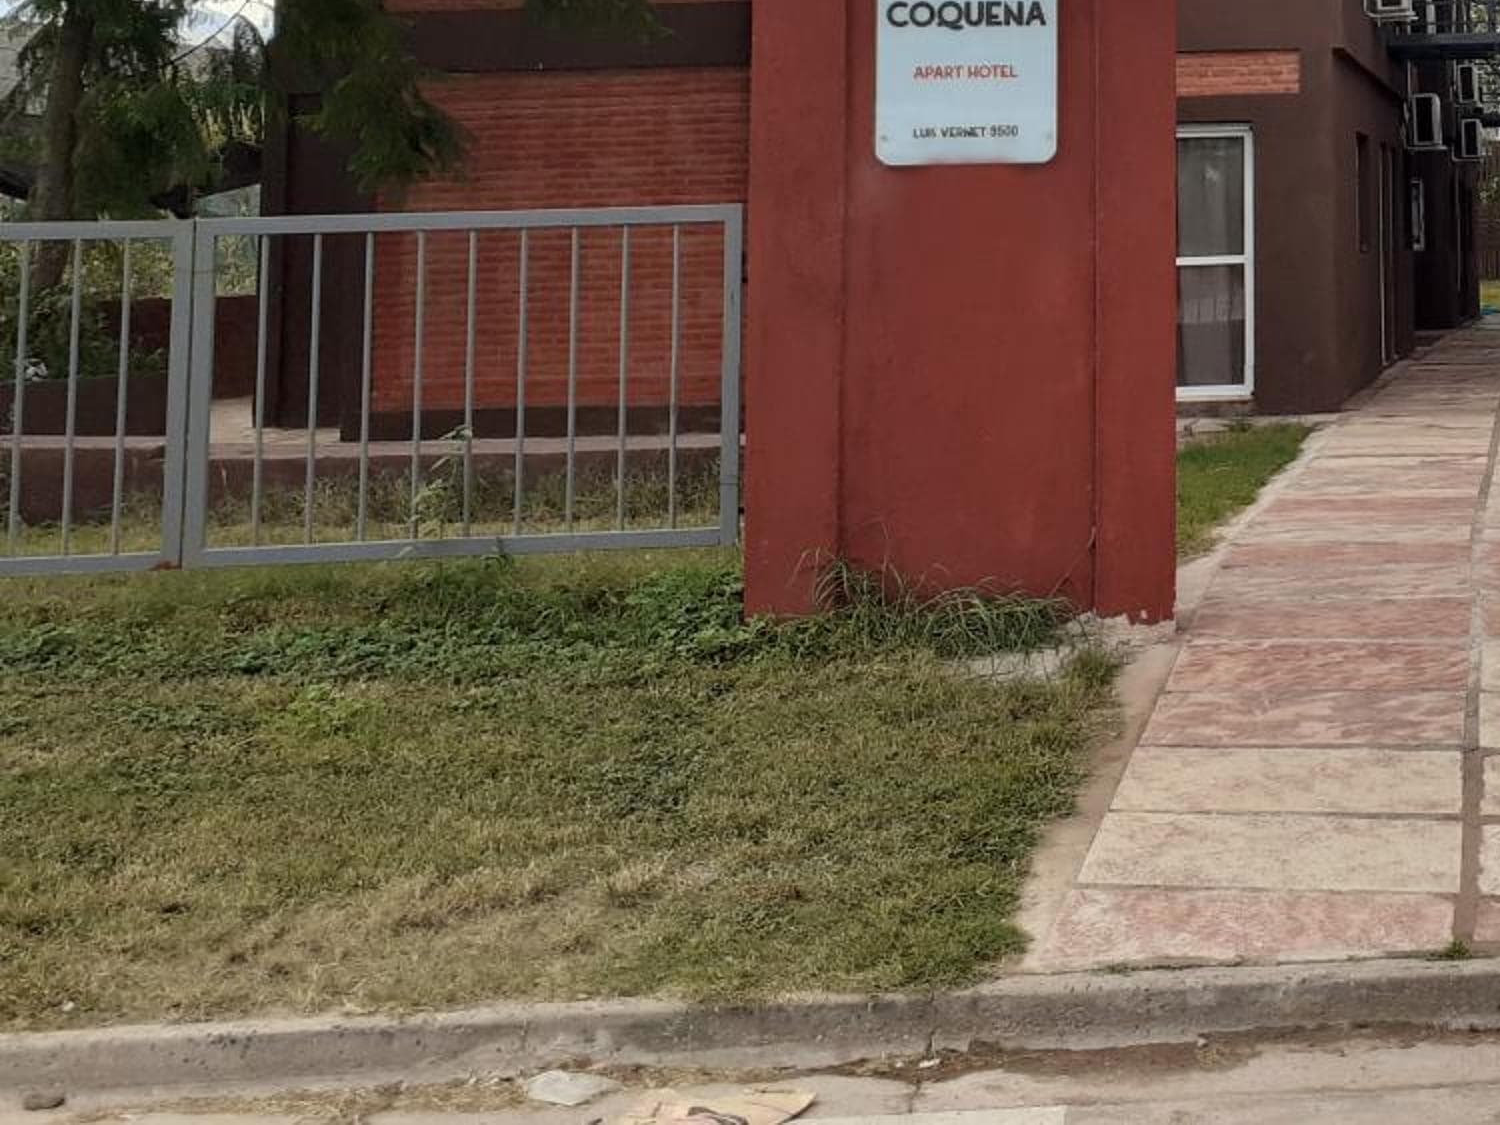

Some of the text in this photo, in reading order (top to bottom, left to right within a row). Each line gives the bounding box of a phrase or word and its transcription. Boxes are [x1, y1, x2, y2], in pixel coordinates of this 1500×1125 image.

[886, 1, 1047, 30] COQUENA
[913, 64, 1019, 80] APART HOTEL
[913, 127, 937, 139] LUIS
[939, 126, 987, 139] VERNET
